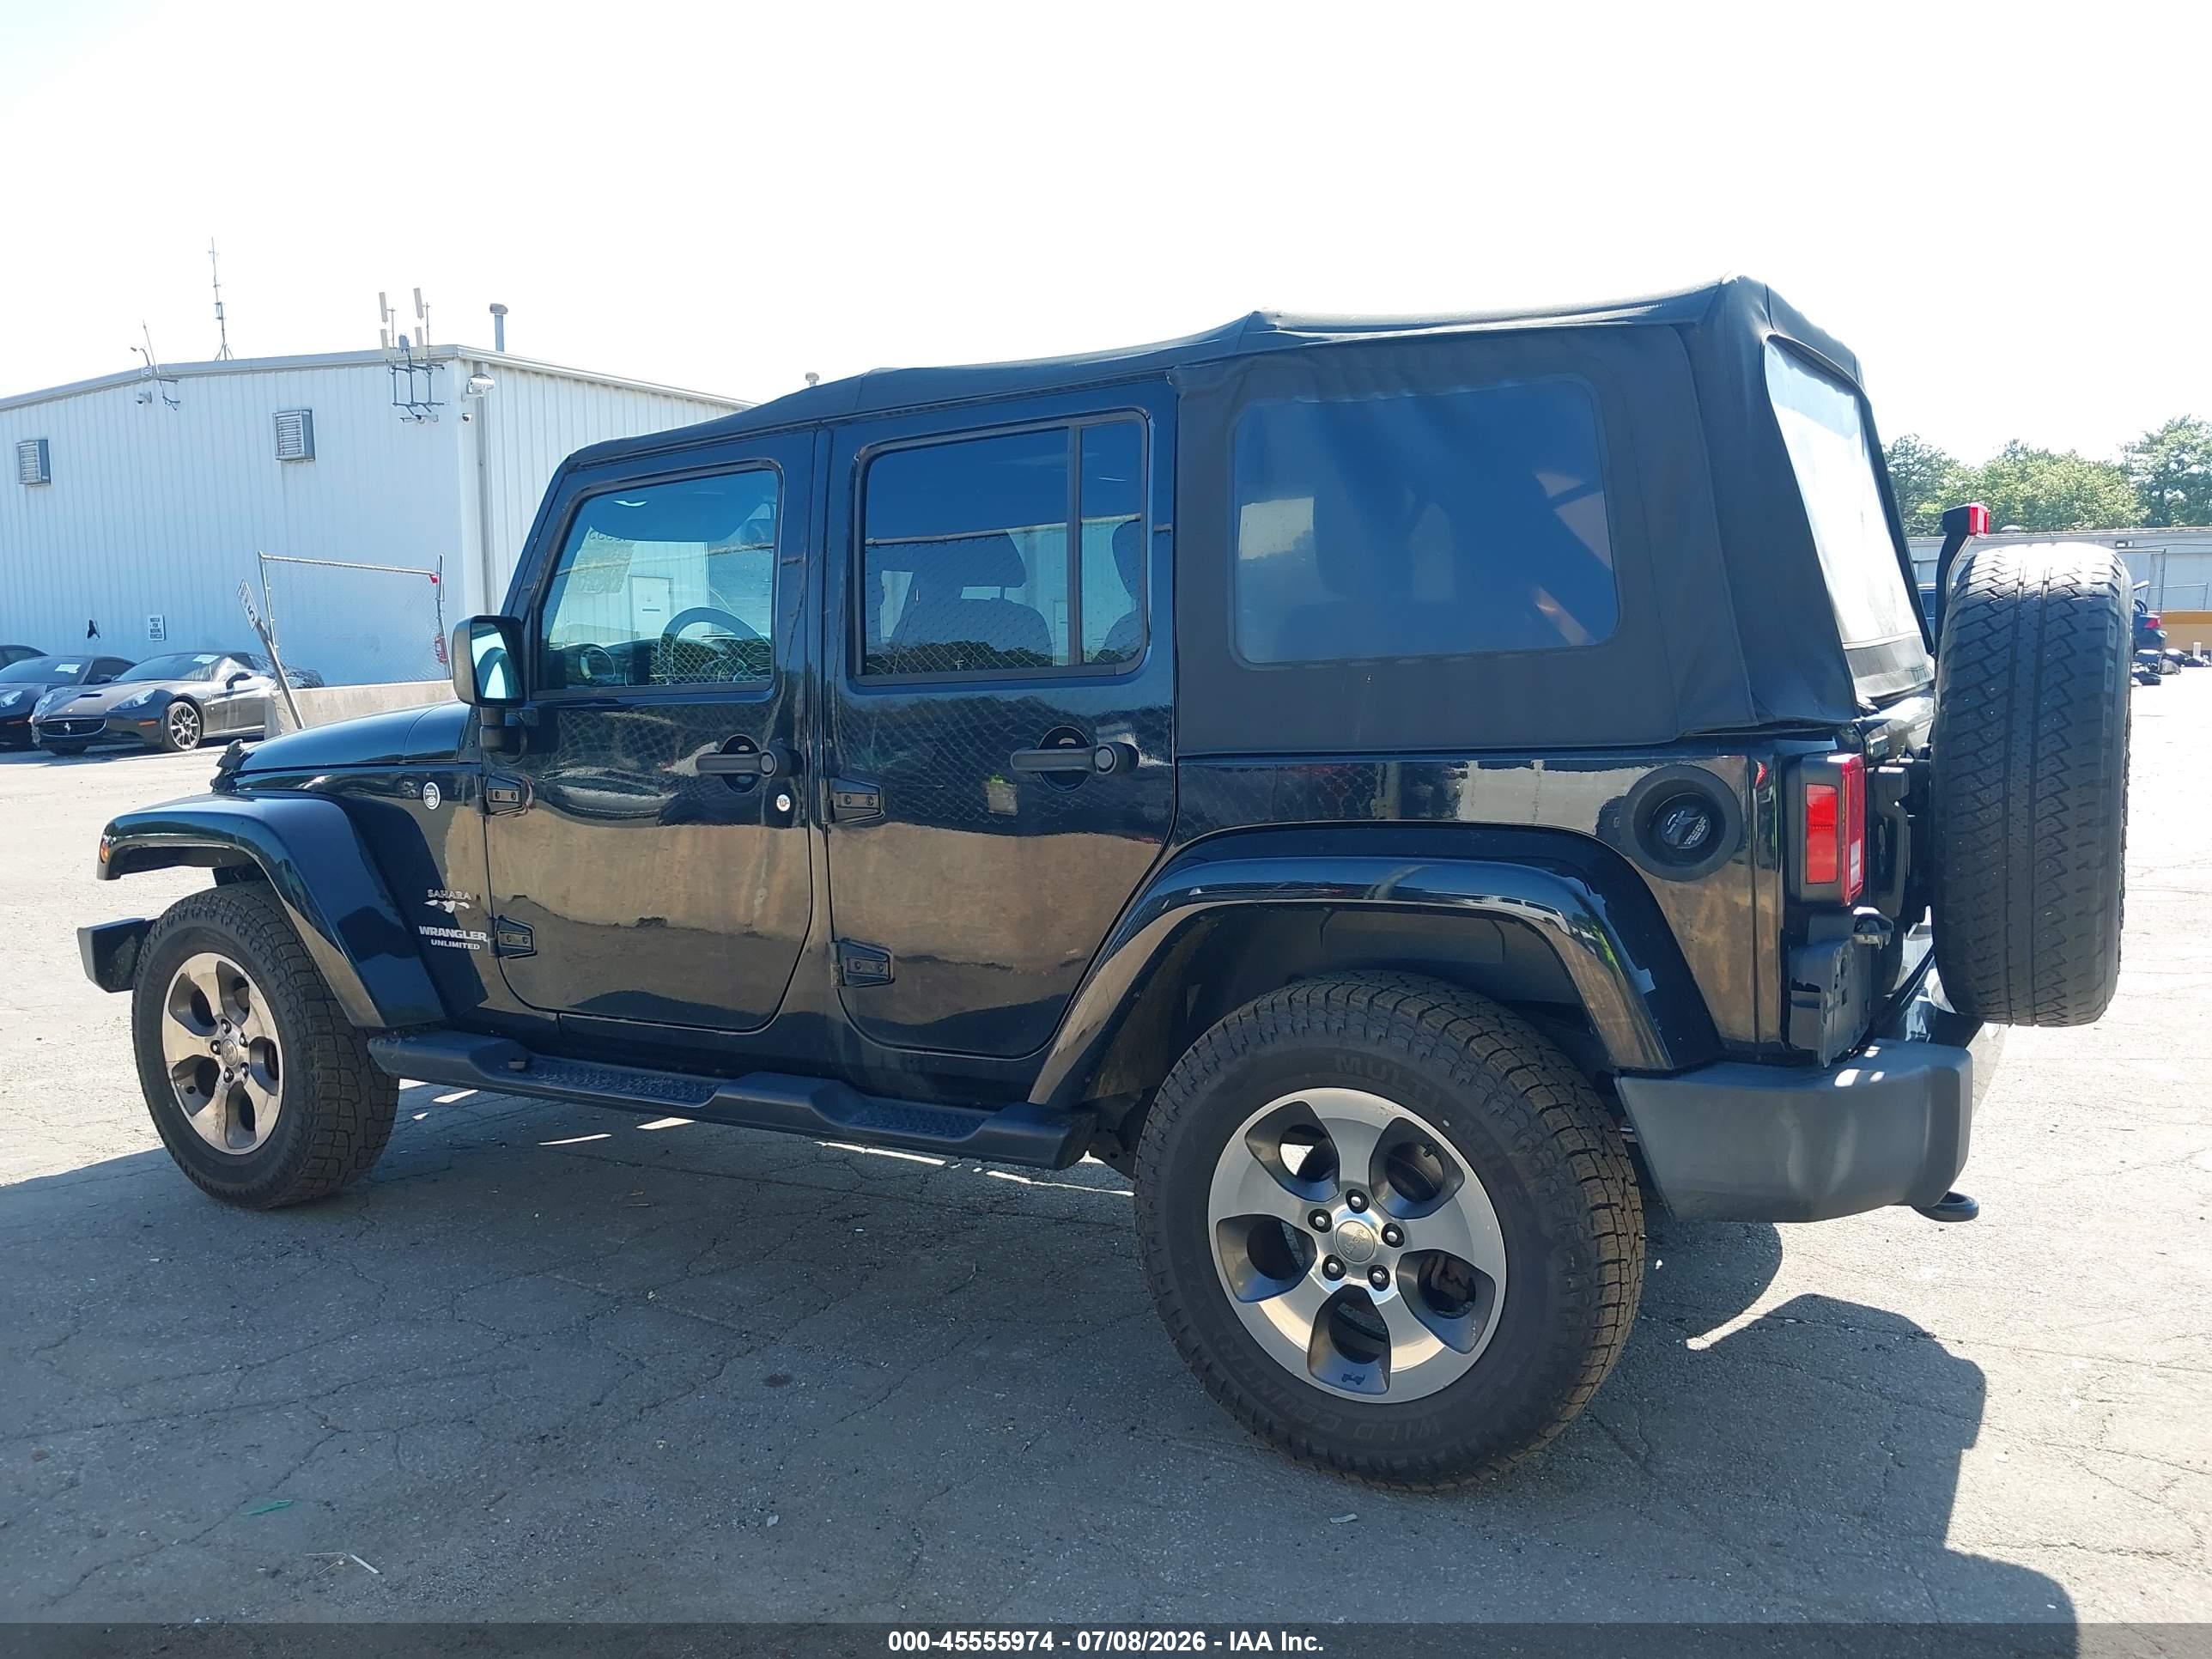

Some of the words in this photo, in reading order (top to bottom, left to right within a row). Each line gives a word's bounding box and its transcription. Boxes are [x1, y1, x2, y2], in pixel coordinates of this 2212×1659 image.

[427, 889, 471, 901] SAHARA
[418, 926, 488, 942] WRANGLER
[430, 939, 481, 950] UNLIMITED
